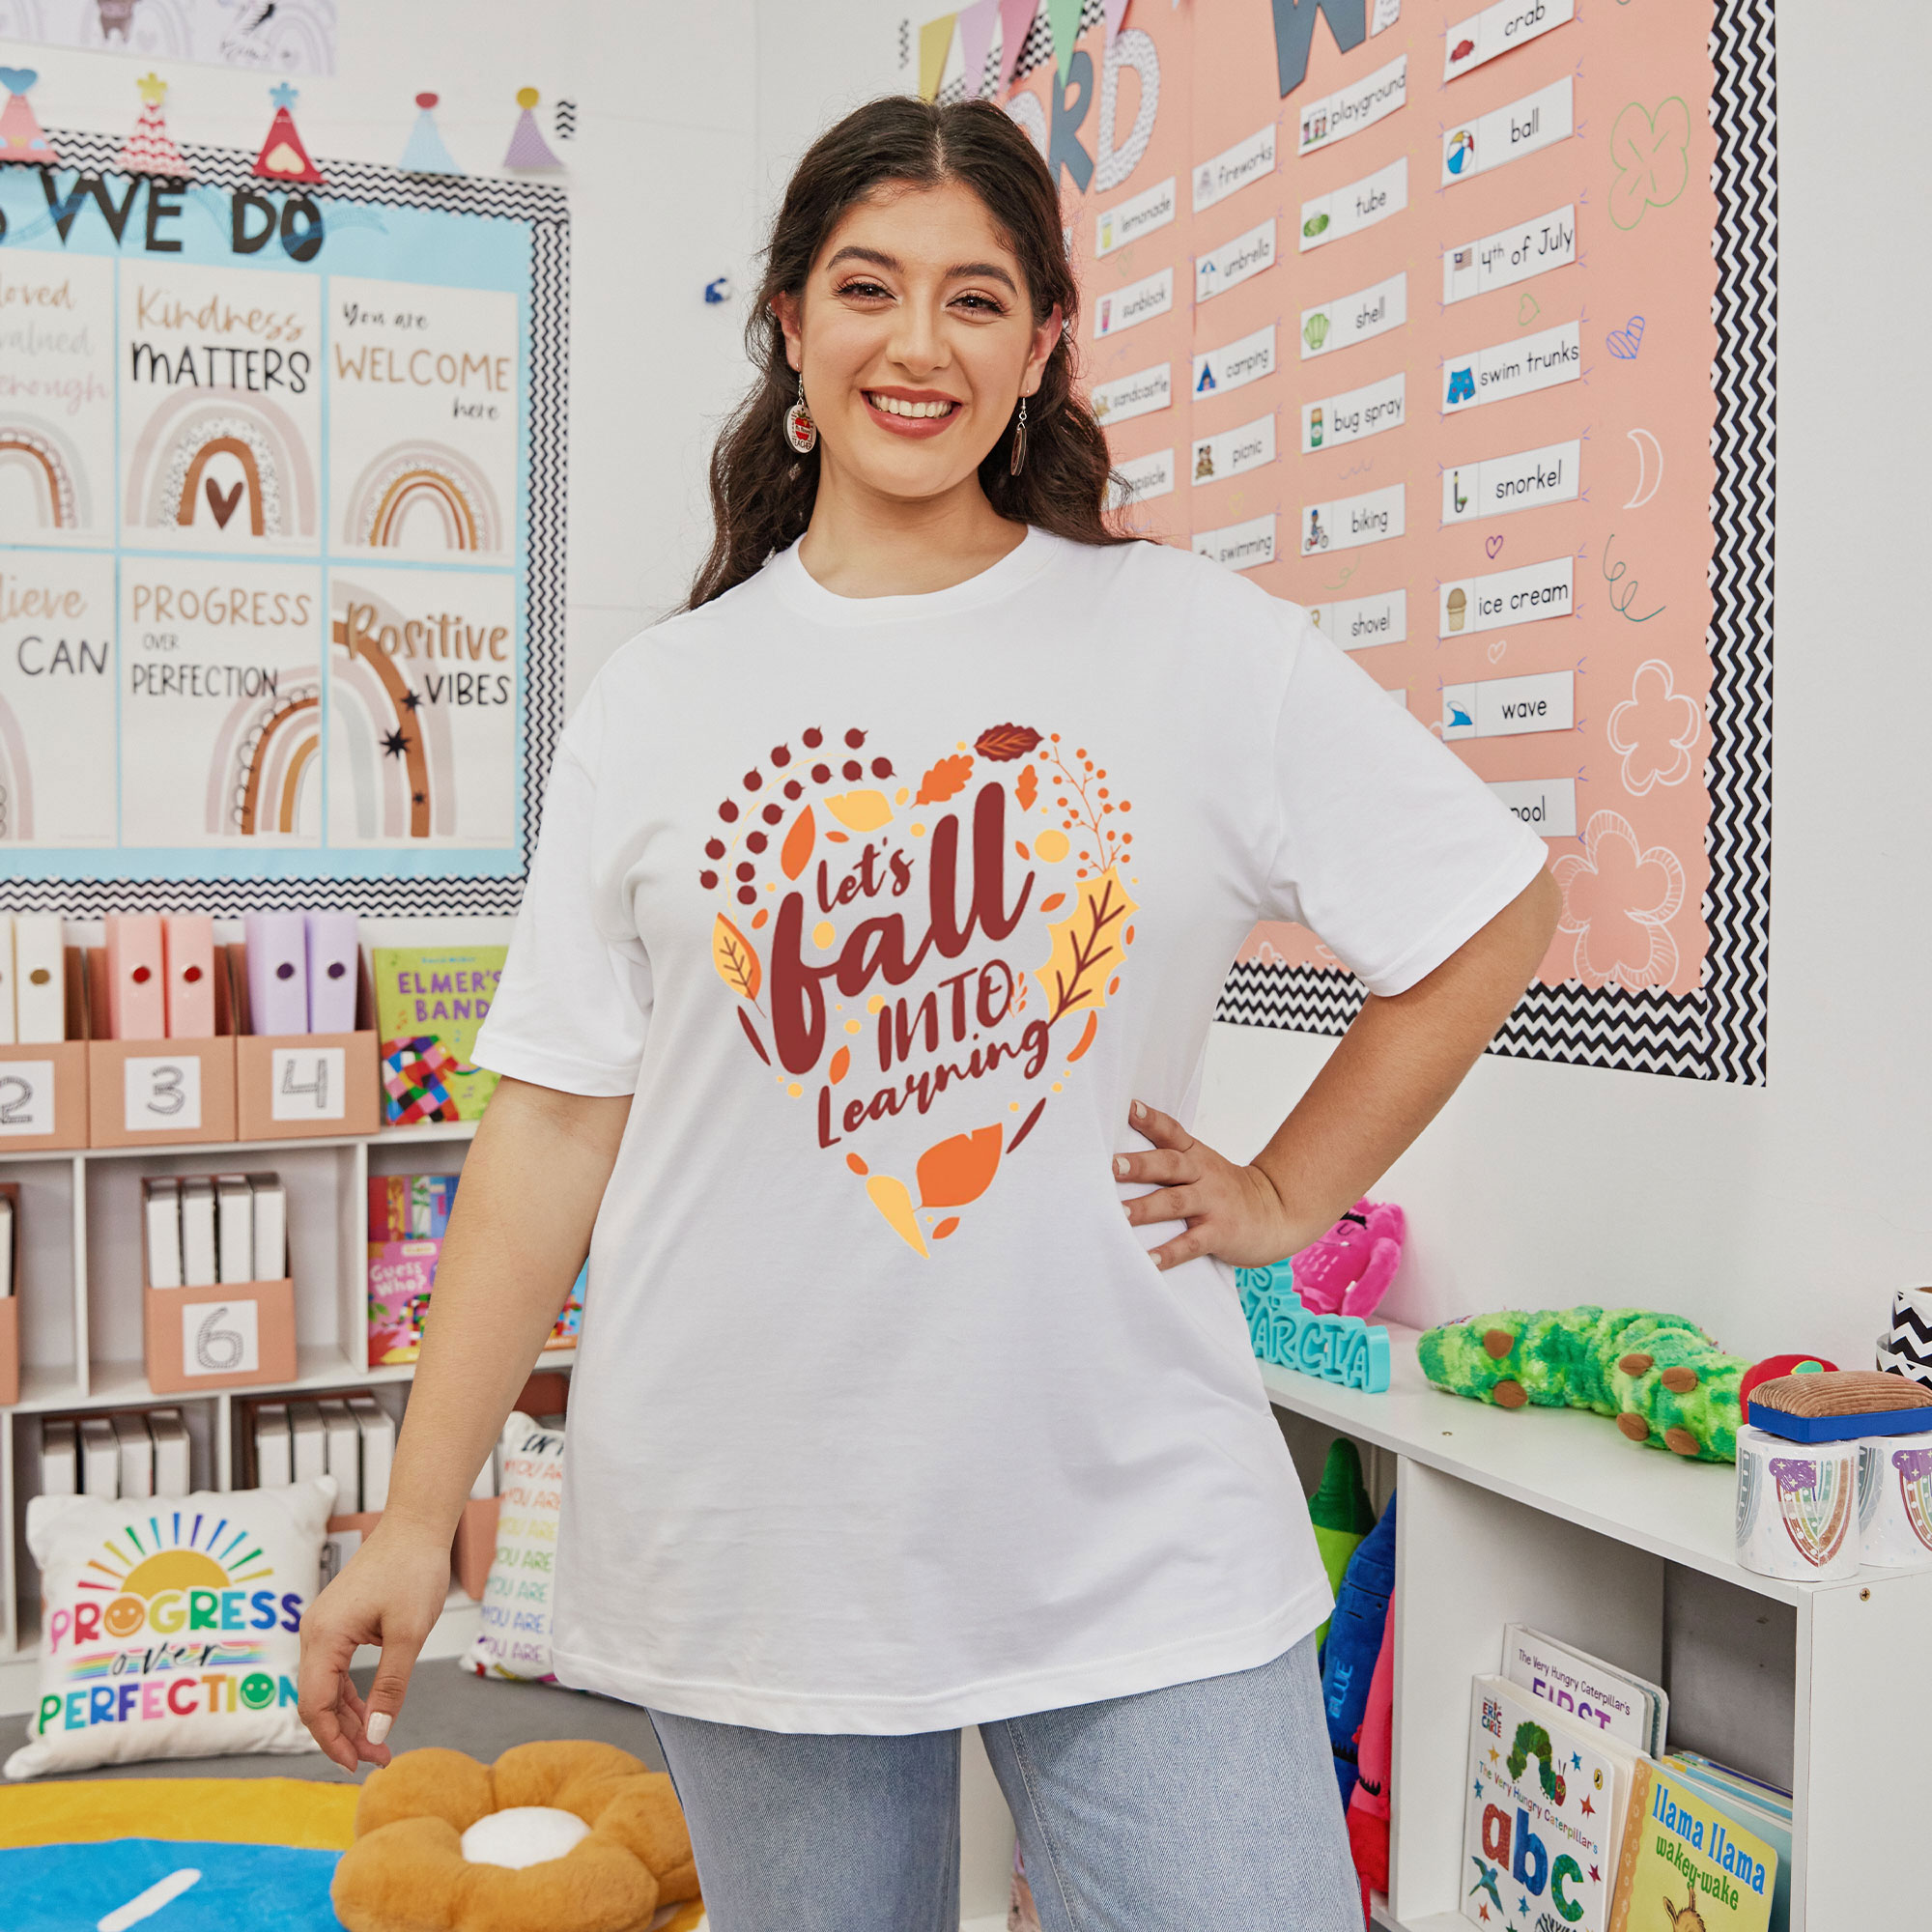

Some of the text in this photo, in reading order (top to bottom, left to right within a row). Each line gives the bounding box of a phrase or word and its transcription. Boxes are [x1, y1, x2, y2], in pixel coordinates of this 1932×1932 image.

[1505, 0, 1546, 36] crab
[1331, 64, 1406, 130] playground
[1511, 107, 1539, 143] ball
[1218, 145, 1274, 188] fireworks
[39, 172, 185, 253] WE
[232, 190, 325, 263] DO
[1122, 193, 1171, 232] lemonade
[1356, 188, 1386, 216] tube
[1224, 239, 1270, 277] umbrella
[1482, 223, 1573, 273] 4th of July
[137, 286, 304, 341] Kindness
[343, 302, 429, 329] You are
[1122, 283, 1166, 318] sunblock
[1355, 297, 1385, 329] shell
[132, 341, 310, 394] MATTERS
[335, 343, 511, 392] WELCOME
[1226, 349, 1268, 378] camping
[1480, 341, 1579, 386] swim trunks
[454, 397, 498, 420] here
[1113, 376, 1168, 408] sandcastle
[1334, 397, 1403, 433] bug spray
[1232, 440, 1263, 468] picnic
[1495, 460, 1562, 499] snorkel
[1351, 508, 1389, 533] biking
[1219, 536, 1272, 563] swimming
[133, 584, 311, 627] PROGRESS
[1479, 582, 1569, 616] ice cream
[348, 603, 508, 661] Positive
[1351, 607, 1391, 637] shovel
[18, 636, 107, 675] CAN
[144, 634, 180, 651] OVER
[132, 664, 277, 697] PERFECTION
[425, 672, 511, 705] VIBES
[1502, 698, 1548, 721] wave
[817, 836, 915, 914] let's
[771, 781, 1036, 1075] fall
[414, 999, 491, 1023] BAND
[878, 959, 1012, 1072] INTO
[0, 1076, 33, 1123] 2
[147, 1065, 185, 1116] 3
[281, 1059, 327, 1109] 4
[369, 1262, 423, 1282] Guess
[375, 1274, 428, 1297] Who?
[196, 1307, 244, 1369] 6
[1243, 1301, 1370, 1388] ARCIA
[523, 1549, 554, 1574] ARE
[517, 1580, 548, 1604] ARE
[50, 1590, 302, 1654] PROGRESS
[513, 1610, 546, 1634] ARE
[110, 1642, 234, 1676] over
[1327, 1659, 1353, 1719] BLUE
[1518, 1648, 1631, 1716] The Very Hungry Caterpillar's
[39, 1671, 299, 1735] PERFECTION
[1483, 1701, 1502, 1724] ERIC
[1481, 1715, 1502, 1739] CARLE
[1480, 1760, 1598, 1855] The Very Hungry Caterpillar's
[1652, 1783, 1766, 1895] llama llama
[1482, 1804, 1584, 1922] abc
[1656, 1835, 1739, 1911] wakey-wake
